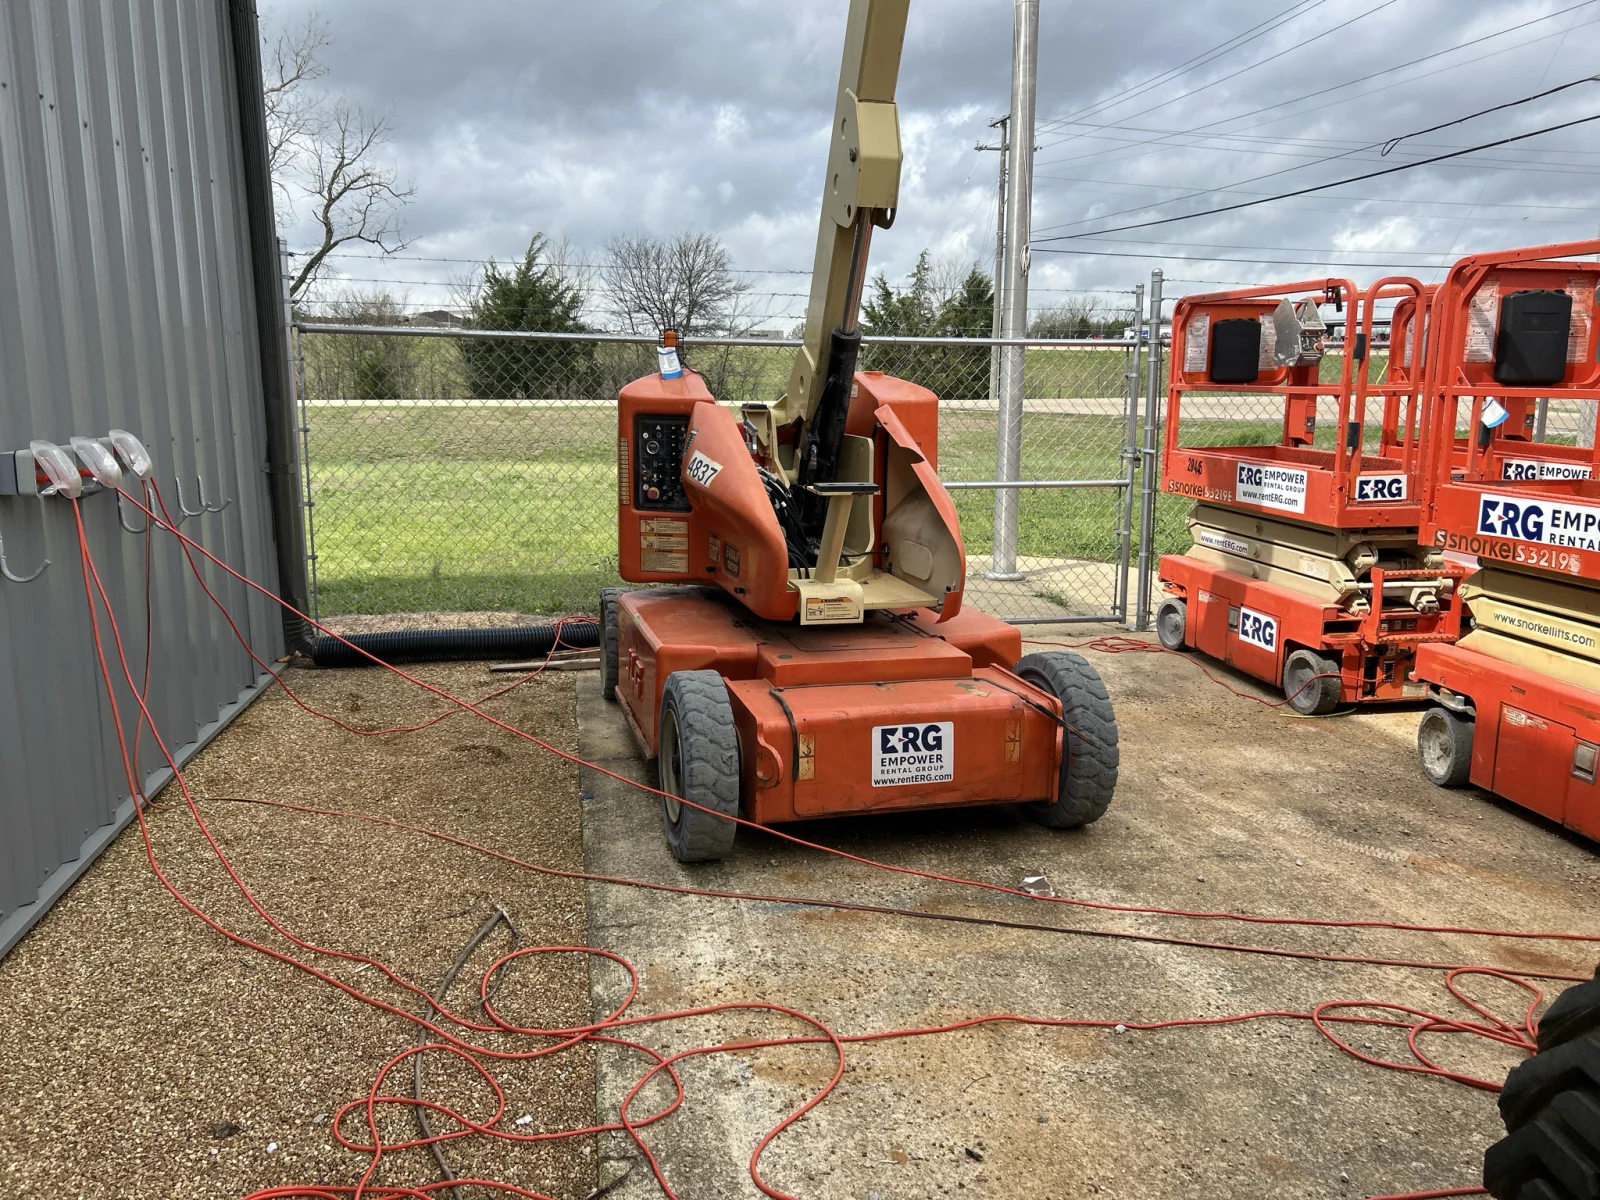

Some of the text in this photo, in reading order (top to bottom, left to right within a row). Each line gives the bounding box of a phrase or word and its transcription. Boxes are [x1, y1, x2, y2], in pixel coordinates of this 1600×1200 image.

[688, 457, 718, 485] 4837
[1238, 466, 1263, 487] ERG
[1264, 470, 1305, 485] EMPOWER
[1503, 463, 1536, 480] ERG
[1174, 481, 1205, 498] snorkel
[1264, 482, 1305, 494] RENTAL GROUP
[1358, 478, 1402, 499] ERG
[1242, 490, 1298, 507] www.rentERG.com
[1480, 500, 1544, 541] ERG
[1201, 534, 1248, 554] www.rentERG.com
[1448, 532, 1516, 561] snorkel
[1241, 612, 1274, 647] ERG
[1493, 612, 1596, 648] www.snorkellifts.com
[881, 724, 942, 754] ERG
[881, 754, 943, 767] EMPOWER
[881, 765, 944, 775] RENTAL GROUP
[873, 773, 952, 786] www.rentERG.com
